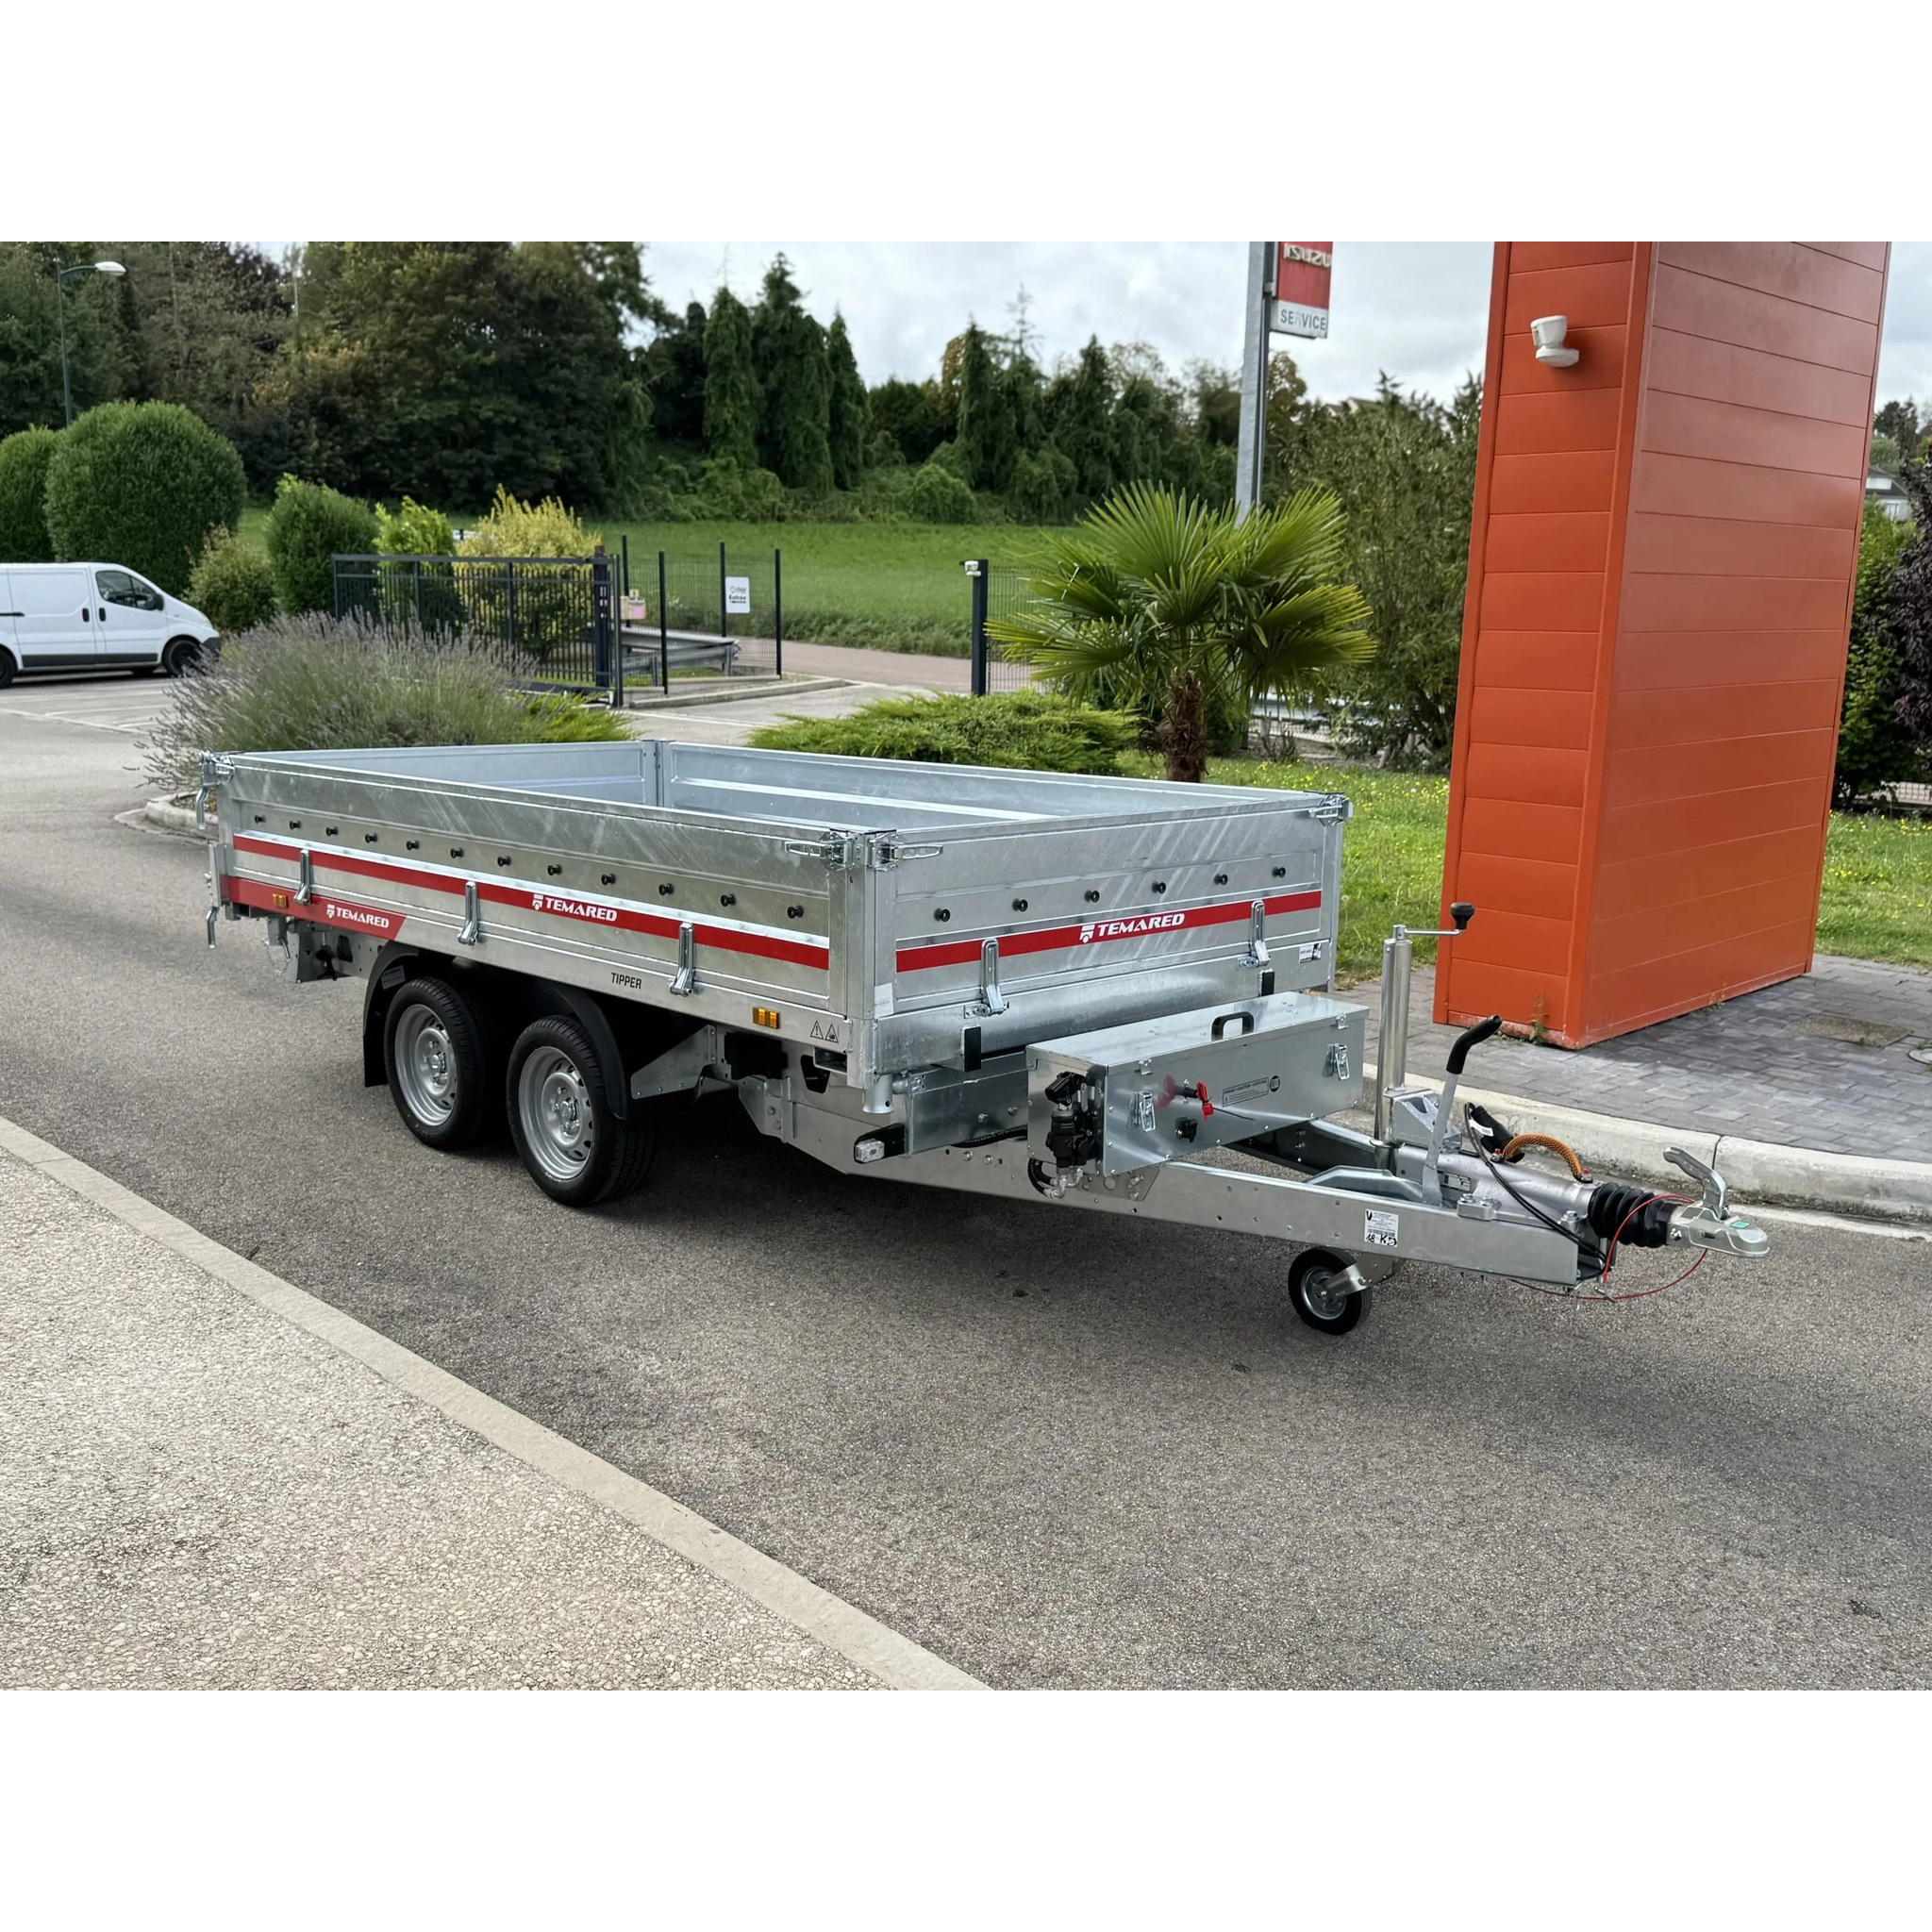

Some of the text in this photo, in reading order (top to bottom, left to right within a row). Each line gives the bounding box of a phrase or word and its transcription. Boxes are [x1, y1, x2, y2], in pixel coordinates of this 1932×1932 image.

[1280, 308, 1326, 330] SERVICE
[336, 907, 390, 928] TEMARED
[544, 897, 618, 922] TEMARED
[1097, 913, 1186, 937] TEMARED
[611, 972, 642, 990] TIPPER
